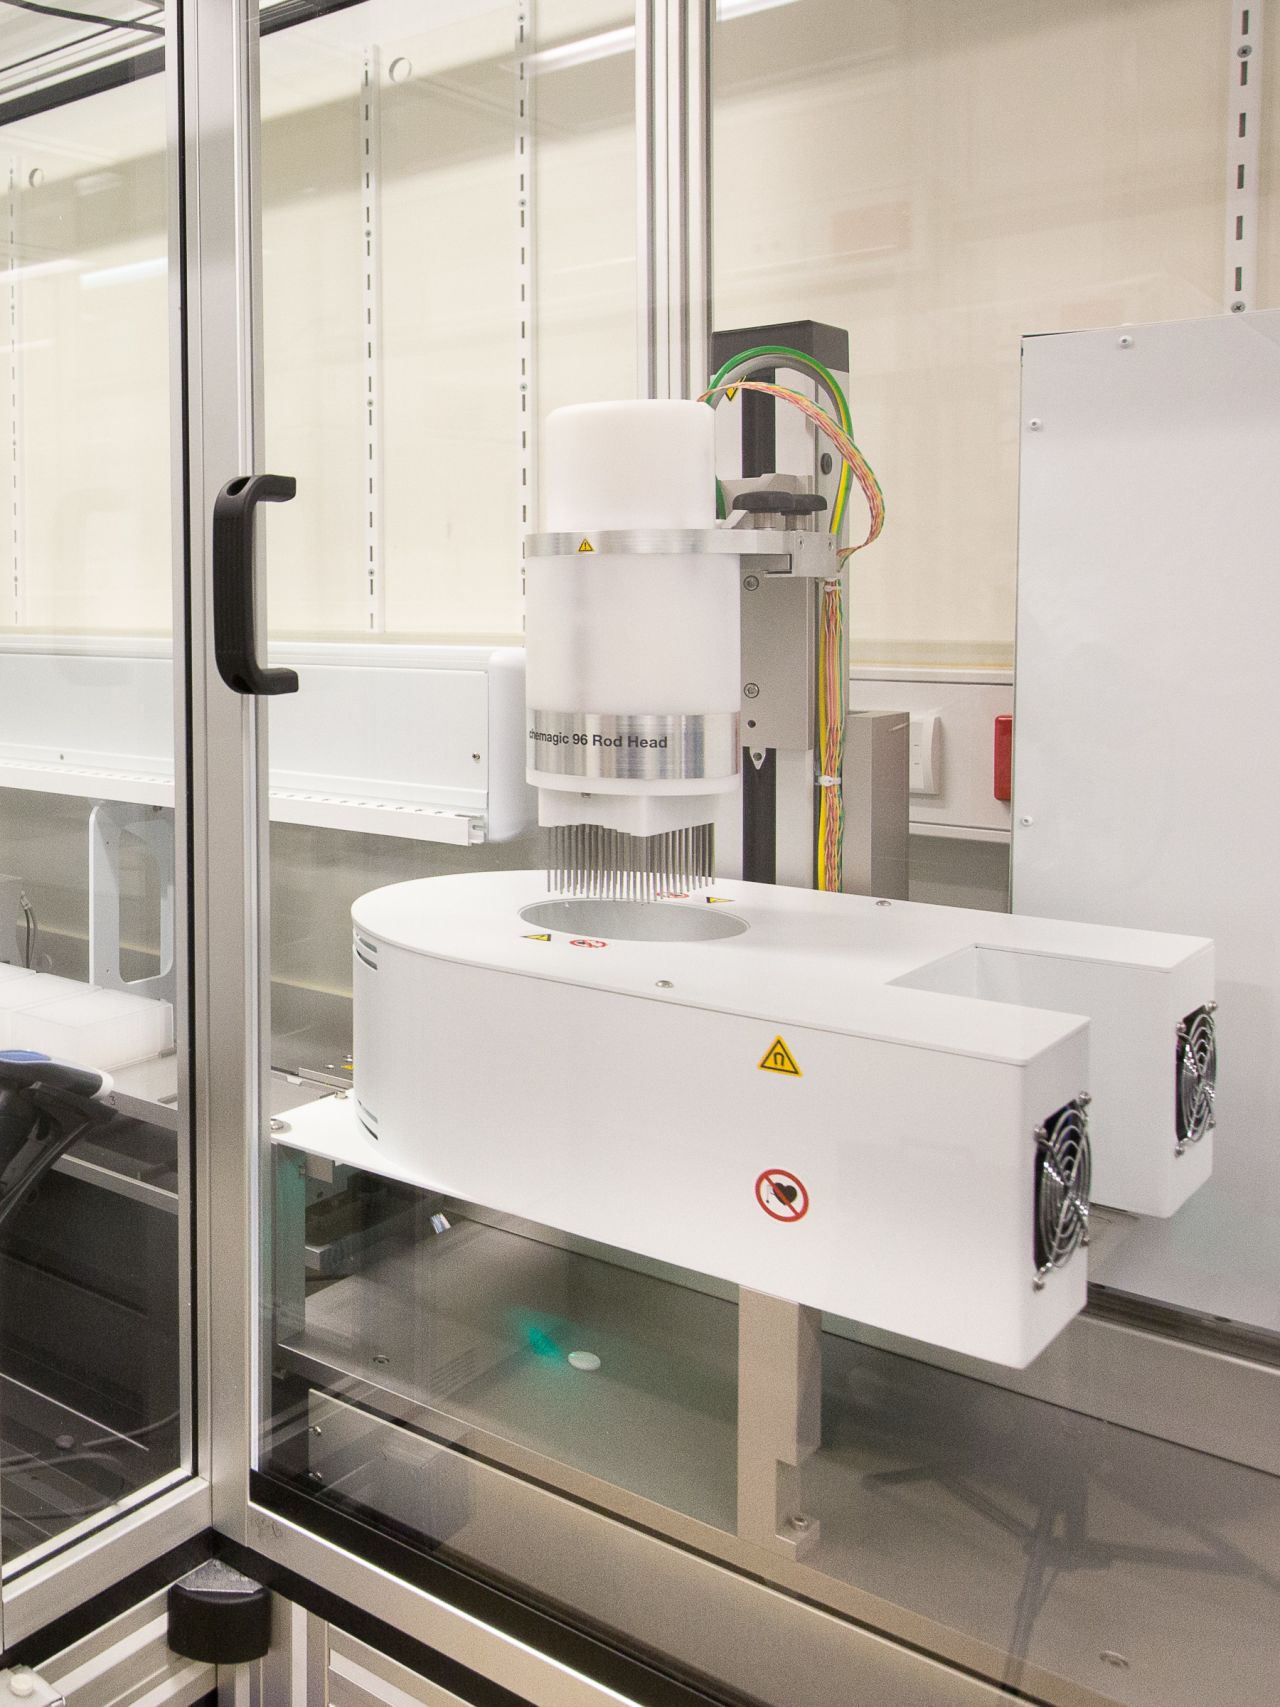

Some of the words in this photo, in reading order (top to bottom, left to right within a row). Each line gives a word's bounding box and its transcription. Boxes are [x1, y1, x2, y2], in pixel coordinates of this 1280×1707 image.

[529, 728, 569, 746] chemagic
[572, 733, 588, 746] 96
[592, 734, 622, 748] Rod
[627, 735, 668, 748] Head
